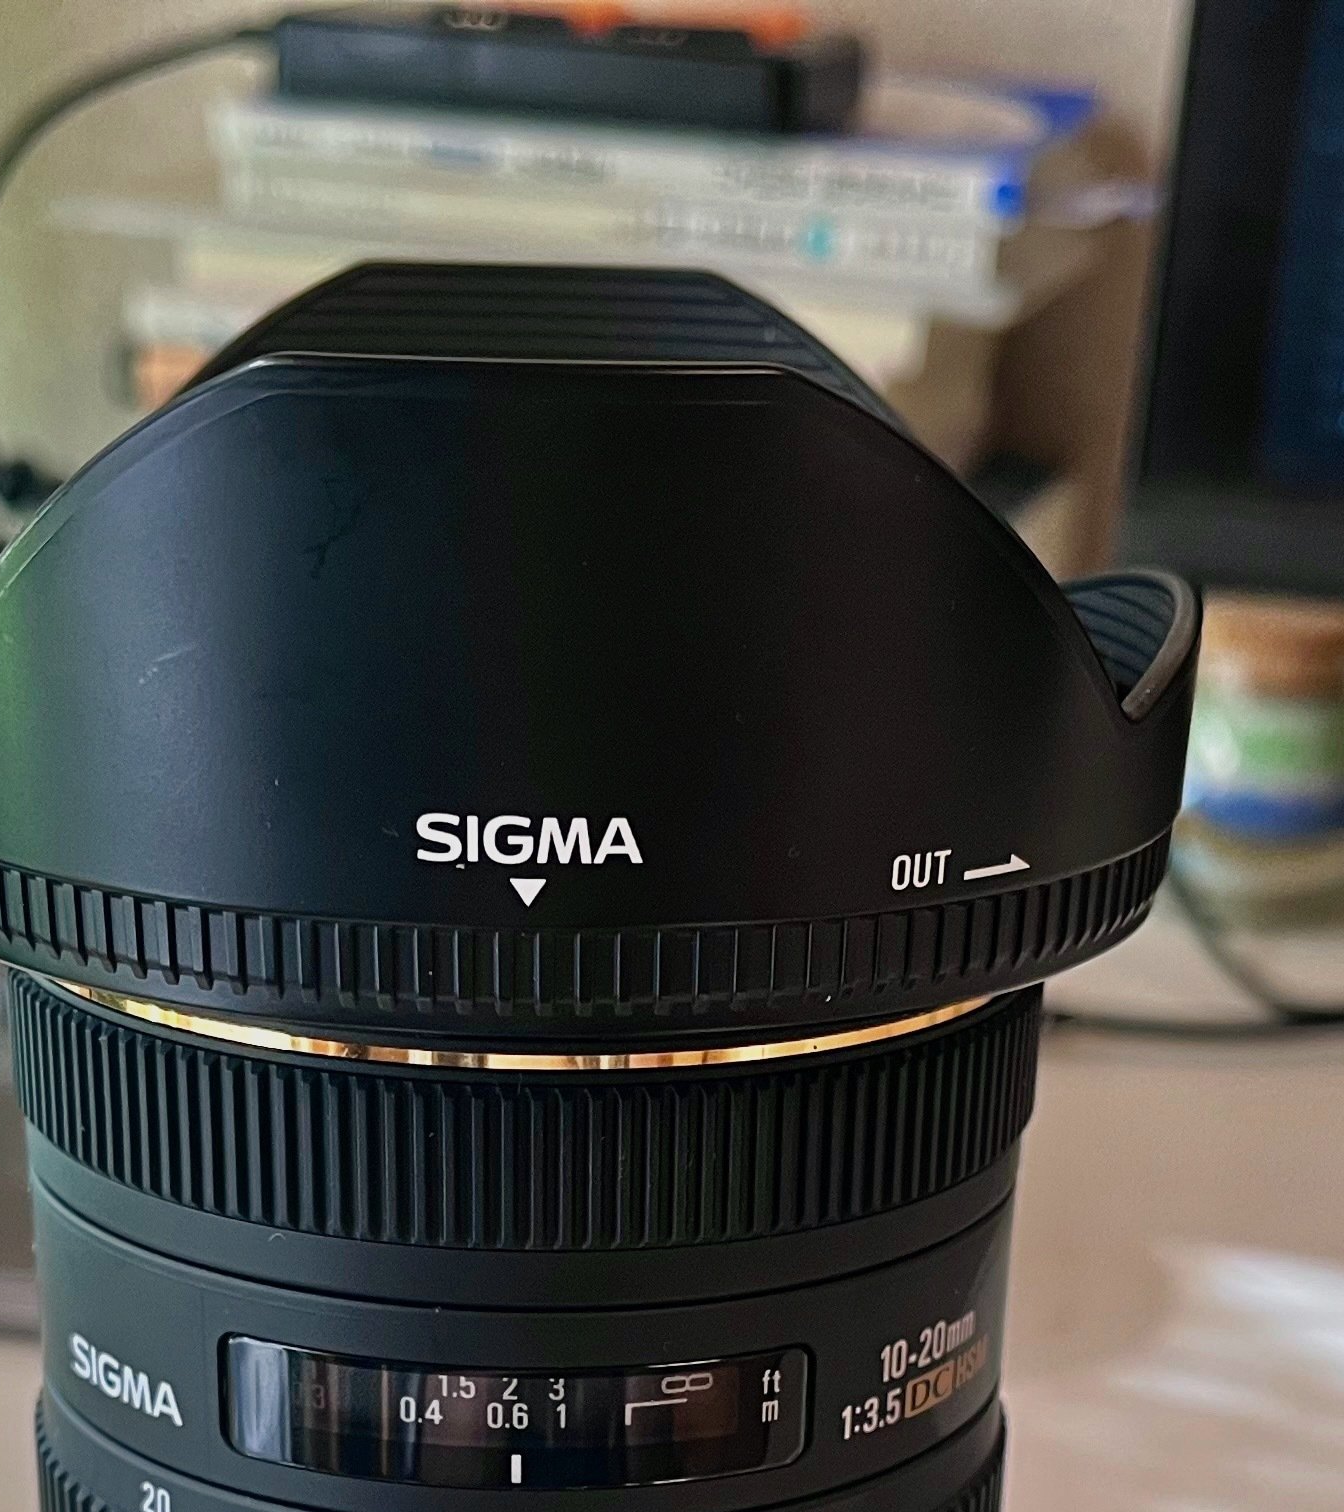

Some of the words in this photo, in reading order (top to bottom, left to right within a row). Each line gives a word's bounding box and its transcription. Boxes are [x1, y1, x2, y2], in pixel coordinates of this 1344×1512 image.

[416, 813, 644, 865] SIGMA
[890, 850, 952, 890] OUT
[880, 1310, 976, 1384] 10-20mm
[69, 1332, 183, 1427] SIGMA
[438, 1374, 476, 1399] 1.5
[502, 1377, 519, 1400] 2
[548, 1377, 565, 1400] 3
[762, 1369, 781, 1395] ft
[841, 1387, 902, 1441] 1:3.5
[909, 1365, 952, 1413] DC
[399, 1396, 443, 1425] 0.4
[486, 1402, 529, 1430] 0.6
[556, 1403, 567, 1429] 1
[761, 1400, 779, 1423] m
